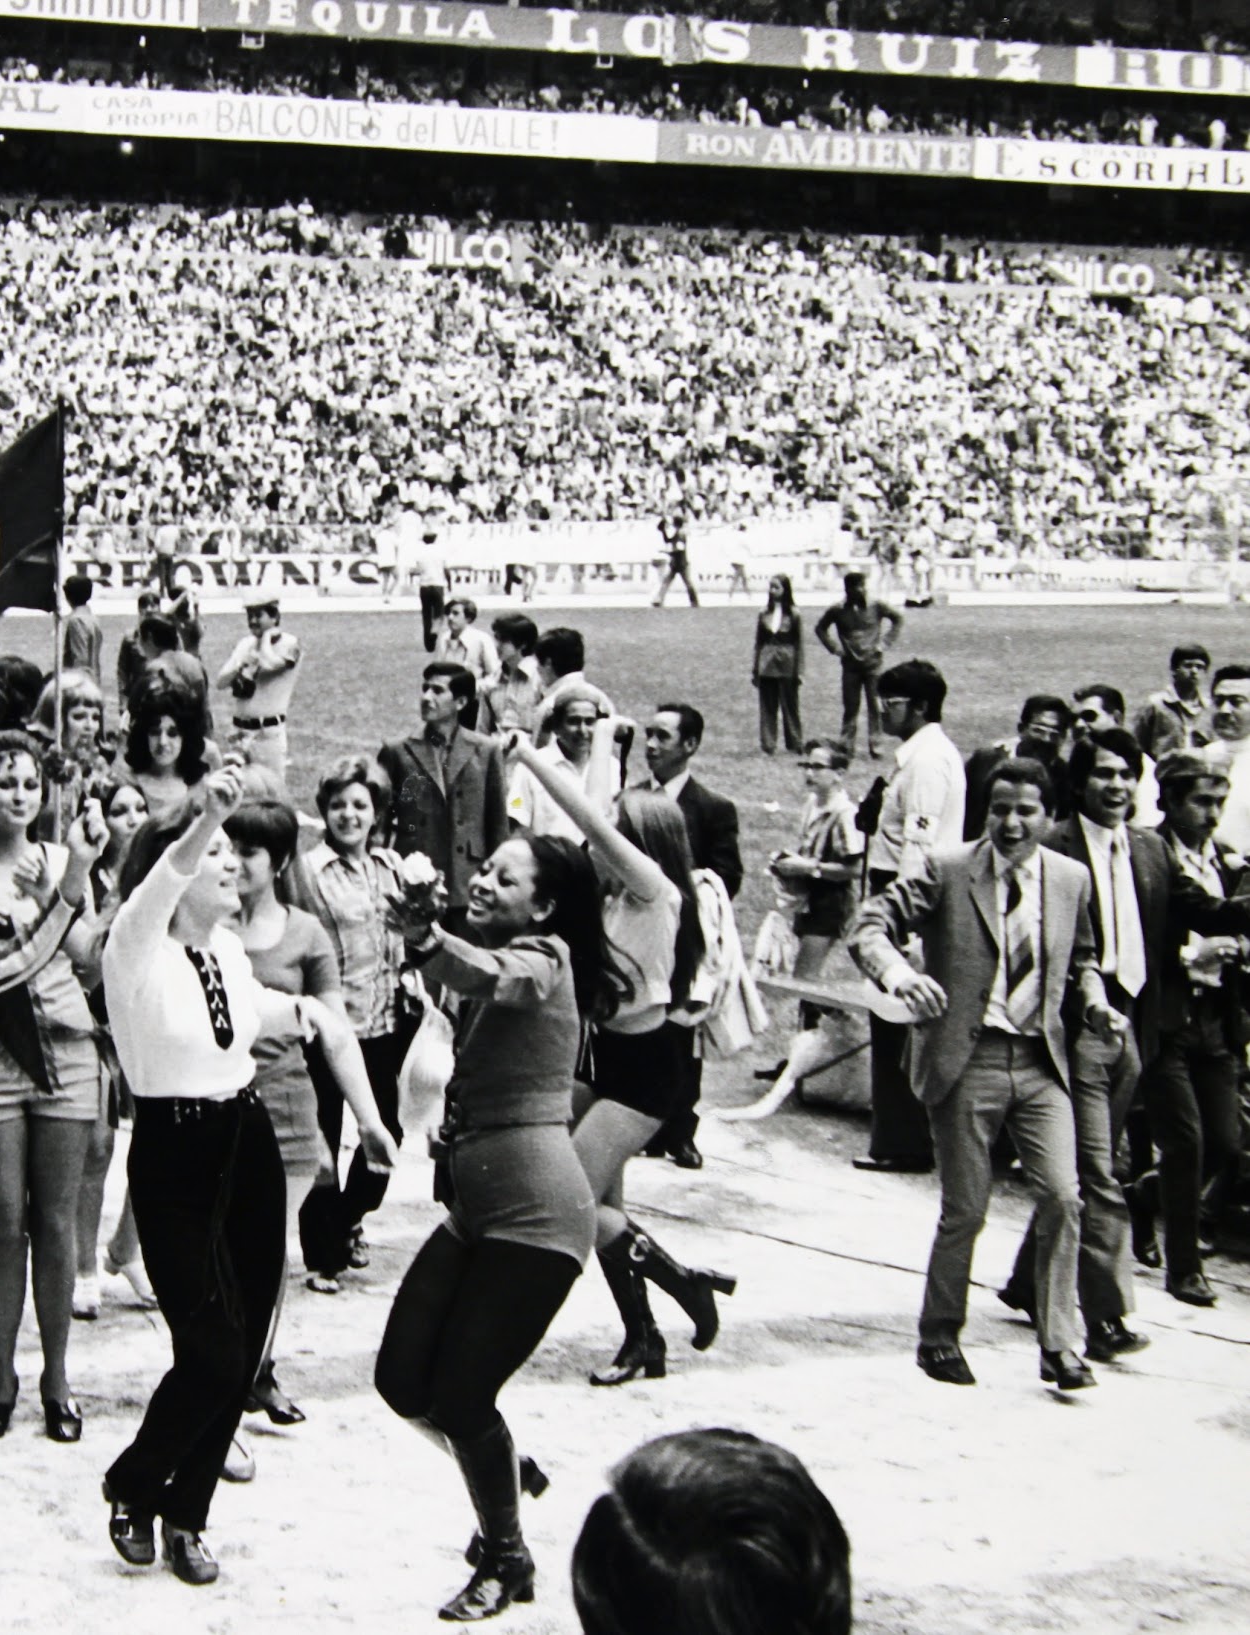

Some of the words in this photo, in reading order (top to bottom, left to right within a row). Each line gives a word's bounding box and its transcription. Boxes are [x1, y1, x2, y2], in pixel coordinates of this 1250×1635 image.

[231, 0, 496, 39] TEQUILA
[545, 8, 751, 64] LOS
[802, 27, 1042, 82] RUIZ
[1108, 48, 1250, 93] RO
[91, 96, 153, 110] CASA
[107, 112, 199, 126] PROPIA
[397, 112, 437, 144] del
[686, 132, 756, 157] RON
[761, 133, 974, 174] AMBIENTE
